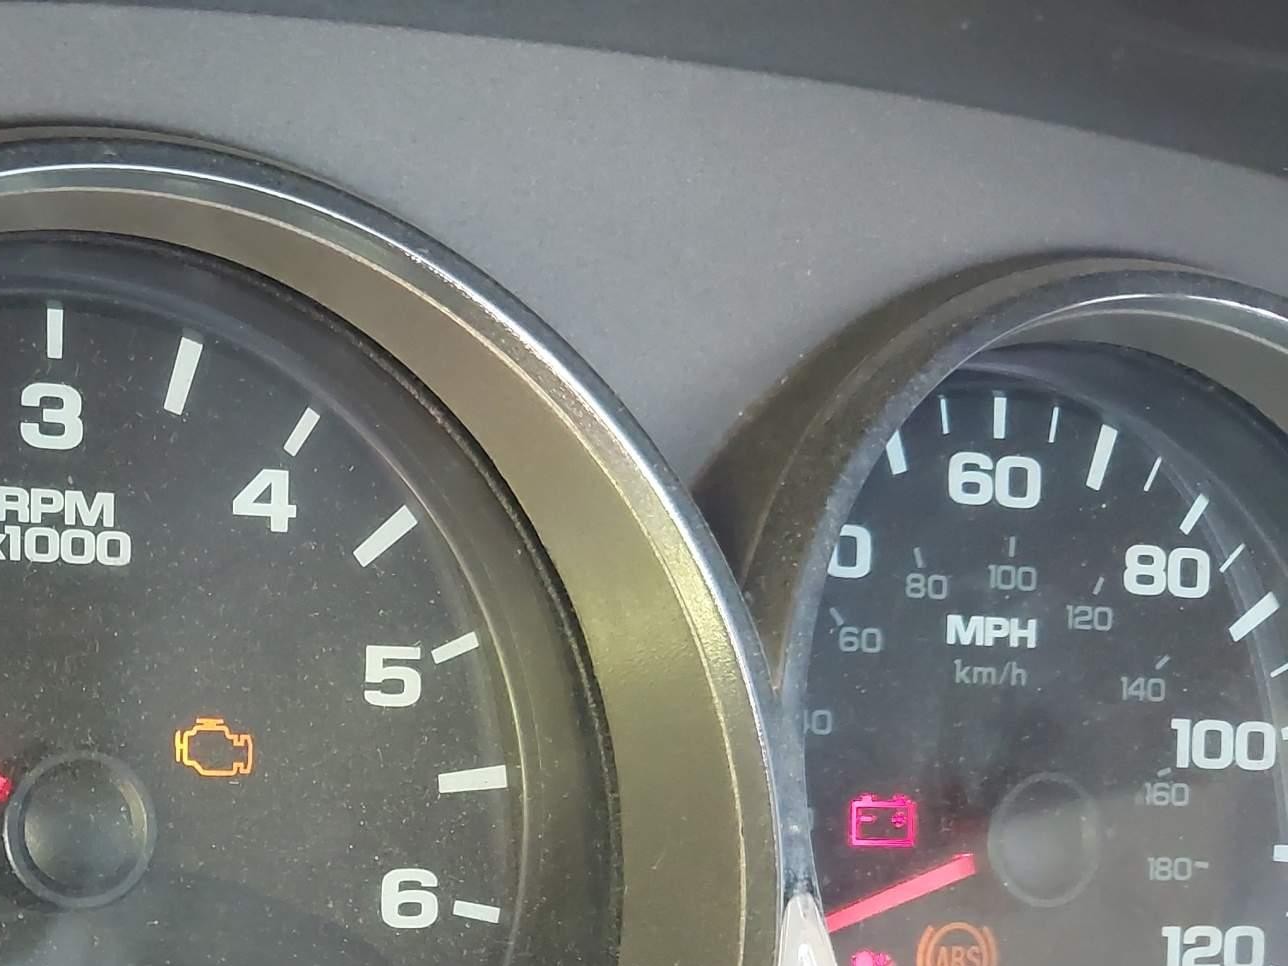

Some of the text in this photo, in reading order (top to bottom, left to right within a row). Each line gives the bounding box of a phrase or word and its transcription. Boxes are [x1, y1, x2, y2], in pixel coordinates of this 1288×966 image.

[20, 382, 84, 450] 3
[948, 451, 1042, 509] 60
[232, 468, 297, 533] 4
[827, 524, 872, 579] 0
[905, 573, 949, 600] 80
[988, 564, 1037, 592] 100
[1123, 544, 1211, 599] 80
[946, 614, 1037, 649] MPH
[1066, 604, 1113, 632] 120
[838, 626, 882, 653] 60
[363, 644, 422, 707] 5
[954, 658, 1027, 686] km/h
[1120, 676, 1166, 702] 140
[1170, 718, 1276, 771] 100
[1144, 782, 1190, 807] 160
[1147, 856, 1192, 881] 180
[381, 868, 439, 929] 6
